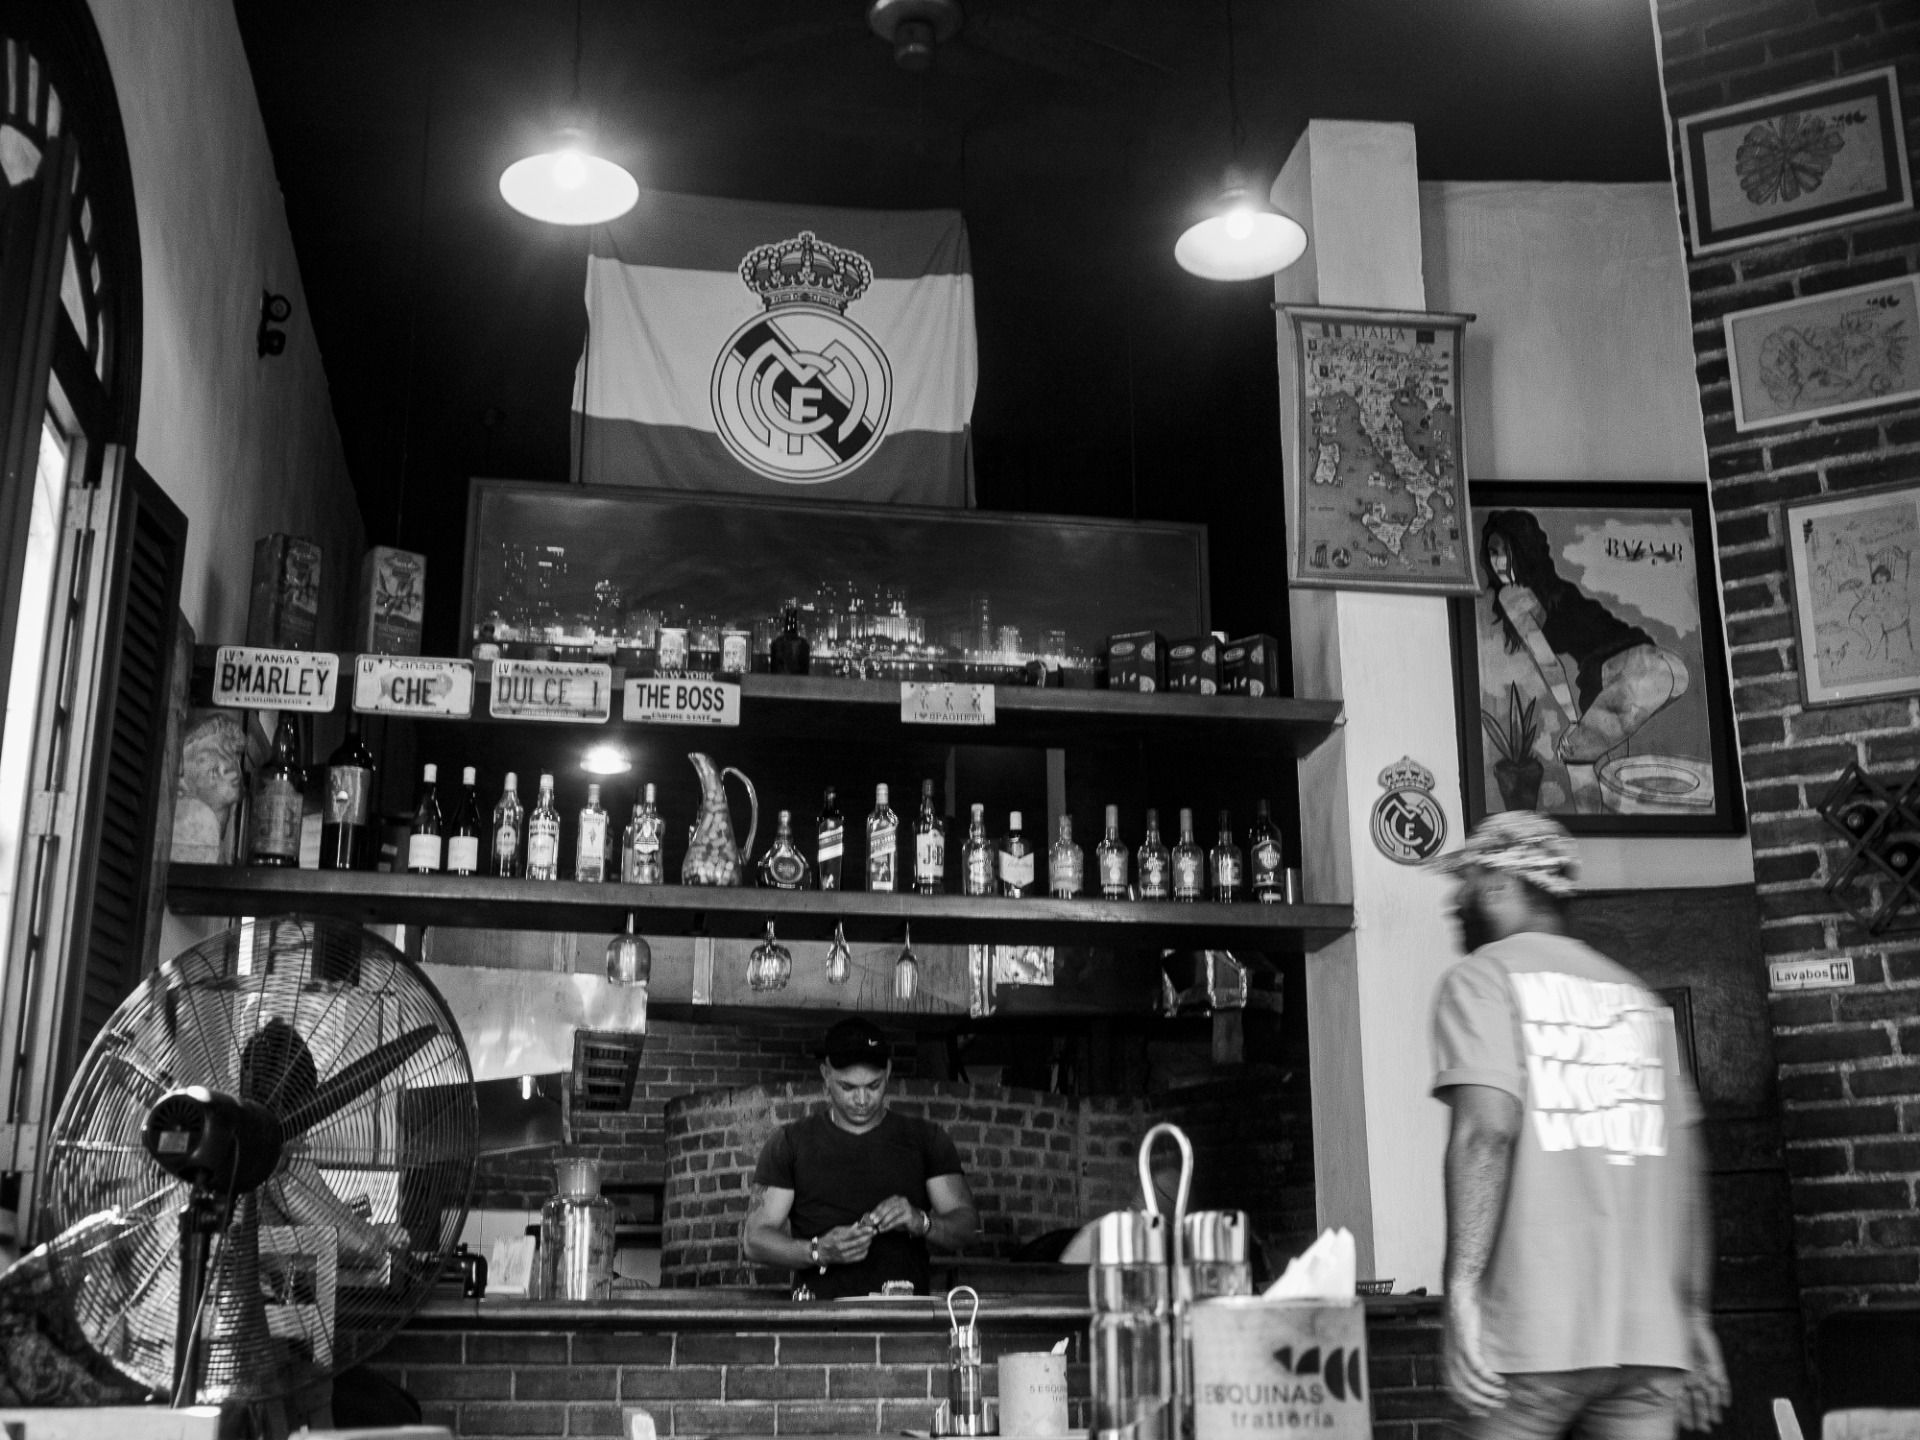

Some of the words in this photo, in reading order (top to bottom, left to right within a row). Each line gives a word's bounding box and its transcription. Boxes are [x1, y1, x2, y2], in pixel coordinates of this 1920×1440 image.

[1353, 325, 1405, 341] ITALIA
[224, 649, 235, 662] LV
[255, 653, 300, 665] KANSAS
[363, 661, 374, 673] LV
[390, 660, 443, 671] Kansas
[498, 663, 509, 674] LV
[521, 665, 583, 676] KANSAS
[221, 663, 329, 696] BMARLEY
[654, 669, 682, 679] NEW
[685, 671, 714, 681] YORK
[391, 676, 437, 706] CHE
[498, 676, 572, 706] DULCE
[636, 683, 670, 709] THE
[677, 685, 724, 712] BOSS
[1776, 968, 1829, 982] Lavabos
